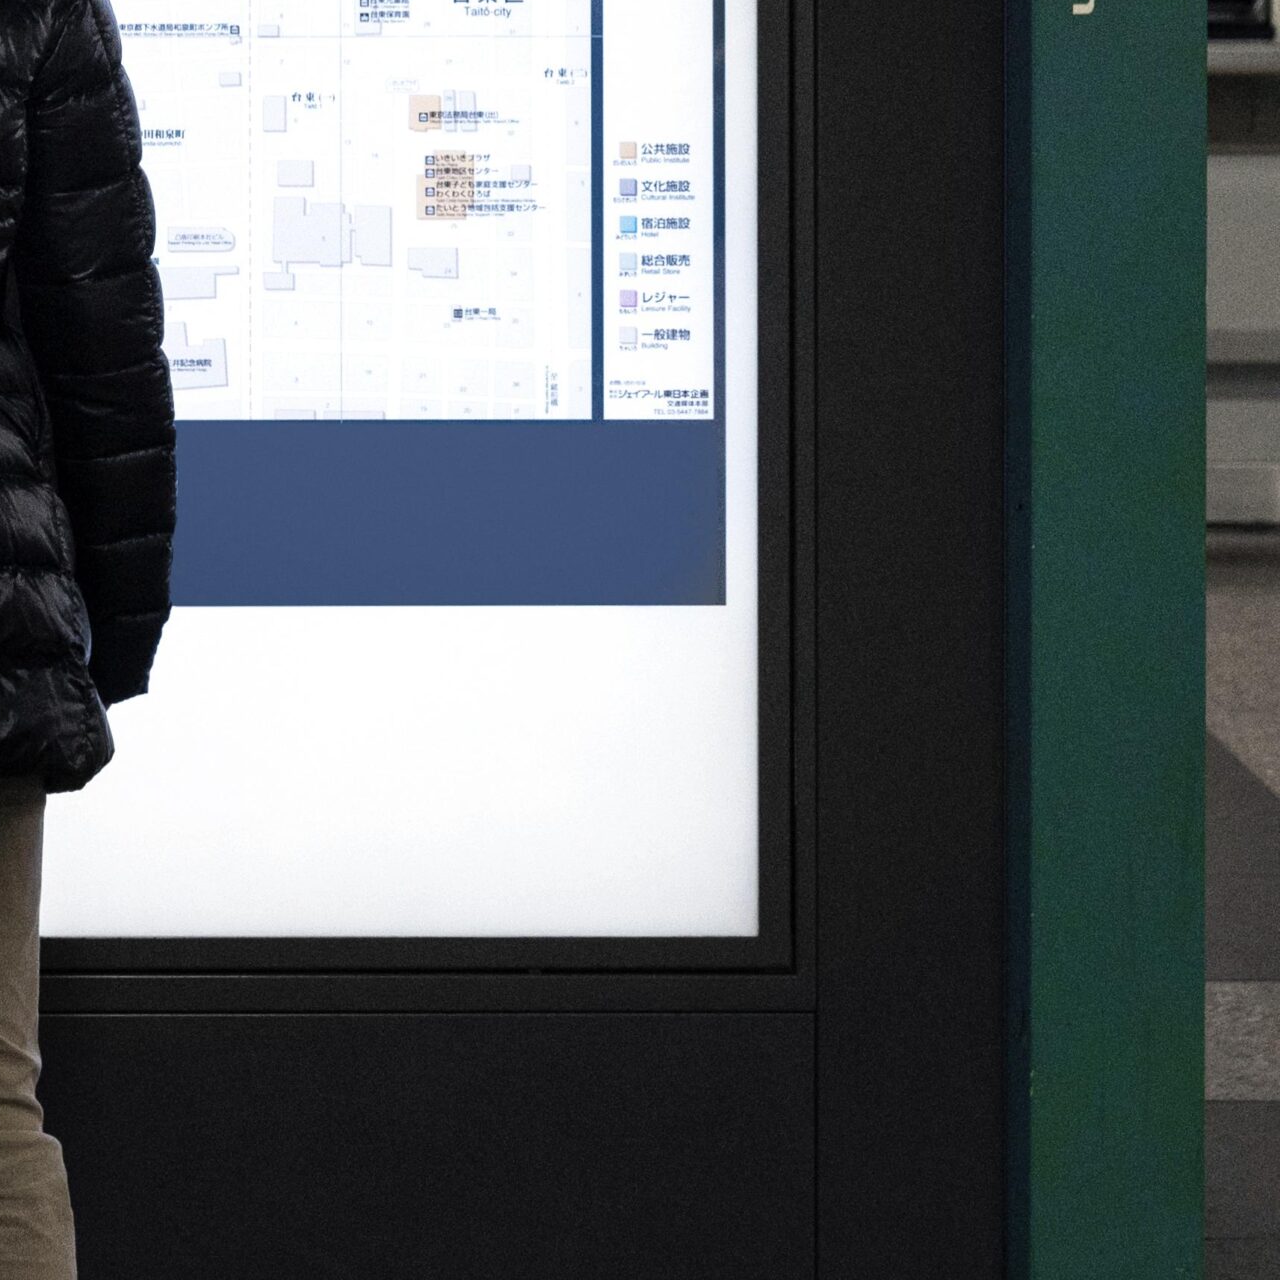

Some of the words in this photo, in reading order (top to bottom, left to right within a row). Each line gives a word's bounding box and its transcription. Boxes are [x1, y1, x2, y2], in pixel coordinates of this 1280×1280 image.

[141, 129, 186, 140] 田和泉町
[641, 143, 690, 155] 公共施設
[641, 180, 690, 192] 文化施設
[641, 217, 690, 230] 宿泊施設
[641, 254, 690, 267] 総合販売
[642, 292, 690, 303] レジャー
[641, 328, 690, 341] 一般建物
